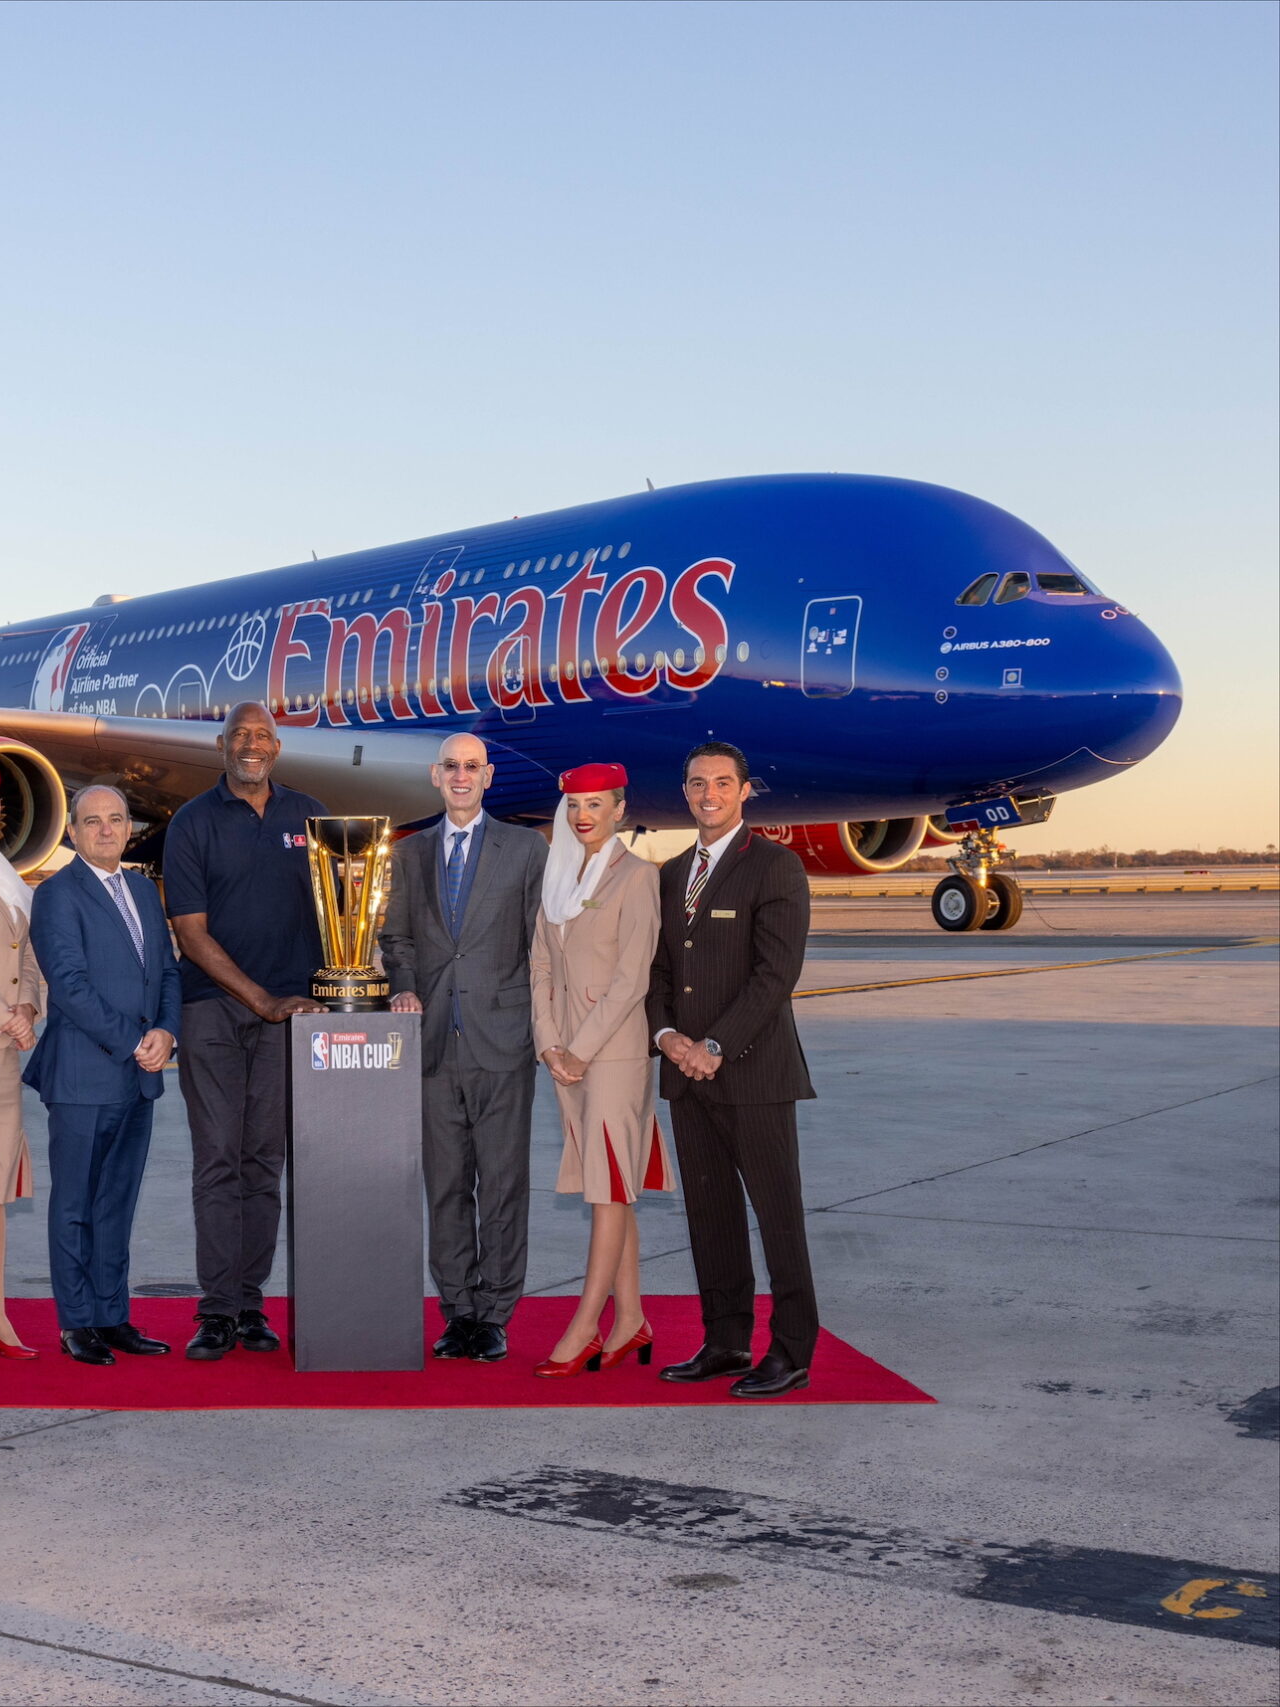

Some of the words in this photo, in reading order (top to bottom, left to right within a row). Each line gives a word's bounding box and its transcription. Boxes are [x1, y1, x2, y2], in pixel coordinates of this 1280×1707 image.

[266, 547, 736, 728] Emirates
[952, 641, 989, 651] AIRBUS
[990, 638, 1050, 648] A380-800
[76, 649, 112, 670] Official
[70, 676, 100, 694] Airline
[102, 673, 138, 690] Partner
[79, 701, 94, 714] the
[96, 698, 117, 714] NBA
[313, 984, 365, 997] Emirates
[367, 984, 379, 996] NBA
[331, 1044, 361, 1069] NBA
[363, 1043, 393, 1069] CUP
